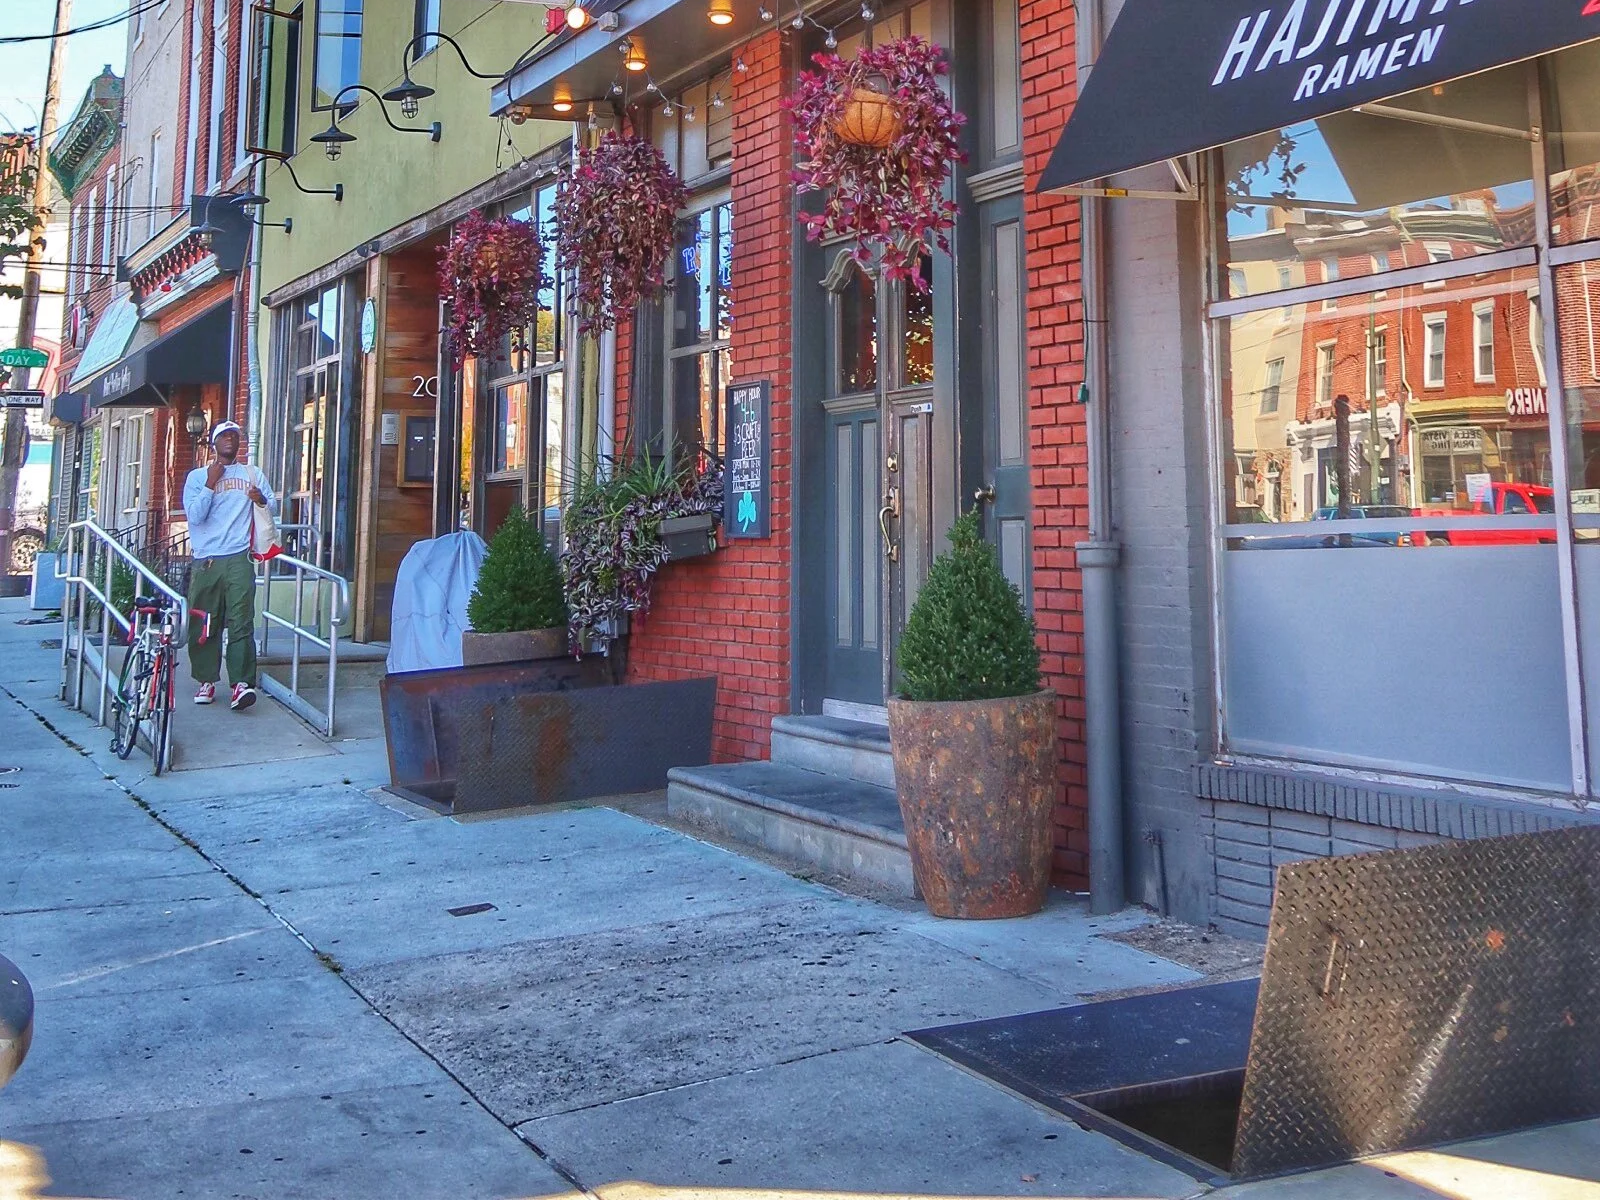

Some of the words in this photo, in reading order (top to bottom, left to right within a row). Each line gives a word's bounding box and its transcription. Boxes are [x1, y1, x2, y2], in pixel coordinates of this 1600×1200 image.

[1293, 24, 1446, 101] RAMEN
[6, 354, 31, 366] DAY
[8, 396, 22, 404] ONE
[748, 386, 761, 402] HOUR
[741, 420, 758, 441] CRAFT
[741, 438, 757, 460] BEER
